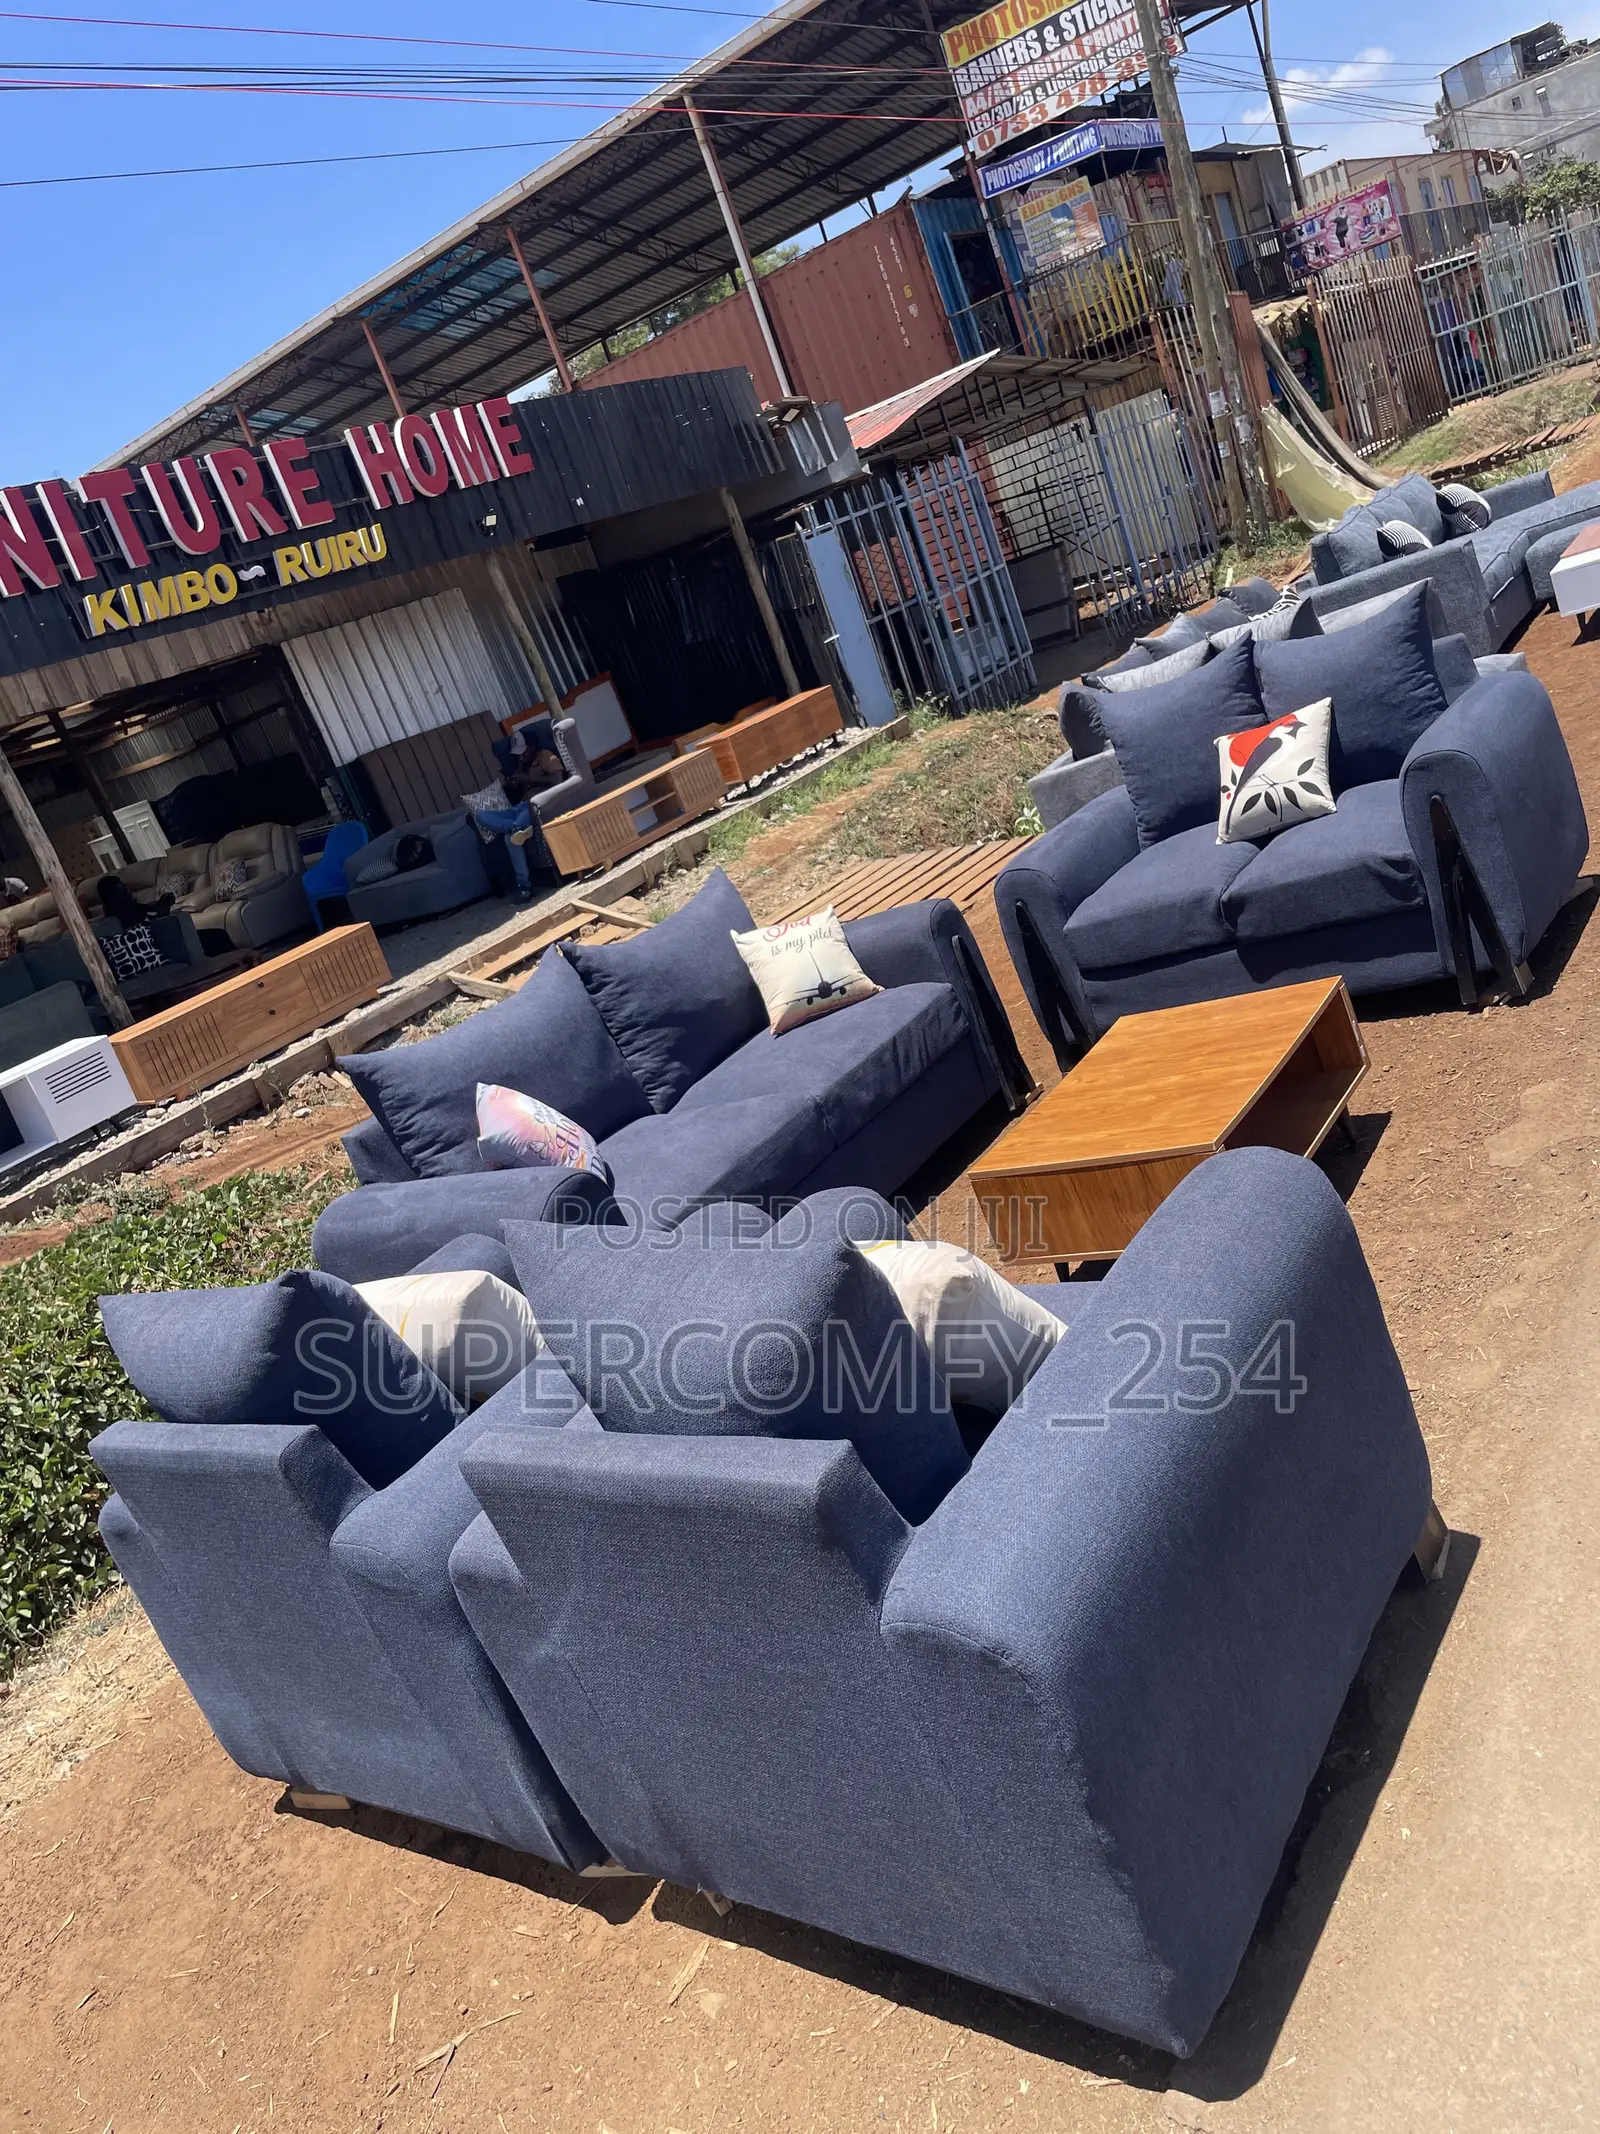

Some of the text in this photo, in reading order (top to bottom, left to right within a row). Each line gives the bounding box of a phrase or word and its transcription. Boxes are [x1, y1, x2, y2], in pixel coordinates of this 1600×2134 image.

[954, 29, 1042, 97] BANNERS
[1043, 25, 1061, 51] &
[965, 76, 1016, 118] A4/A3
[1016, 41, 1082, 92] DIGITAL
[969, 90, 1034, 135] LED/3D/2D
[1034, 86, 1047, 101] &
[1045, 52, 1108, 96] LIGHTBOX
[977, 103, 1049, 151] 0733
[1056, 72, 1108, 109] 478
[1098, 123, 1148, 146] PHOTOSHOOT
[985, 149, 1045, 191] PHOTOSHOOT
[1052, 127, 1097, 164] PRINTING
[1021, 199, 1045, 219] EDU
[0, 396, 535, 598] NITURE HOME
[83, 523, 388, 639] KIMBO RUIRU
[770, 926, 834, 957] is my pilot
